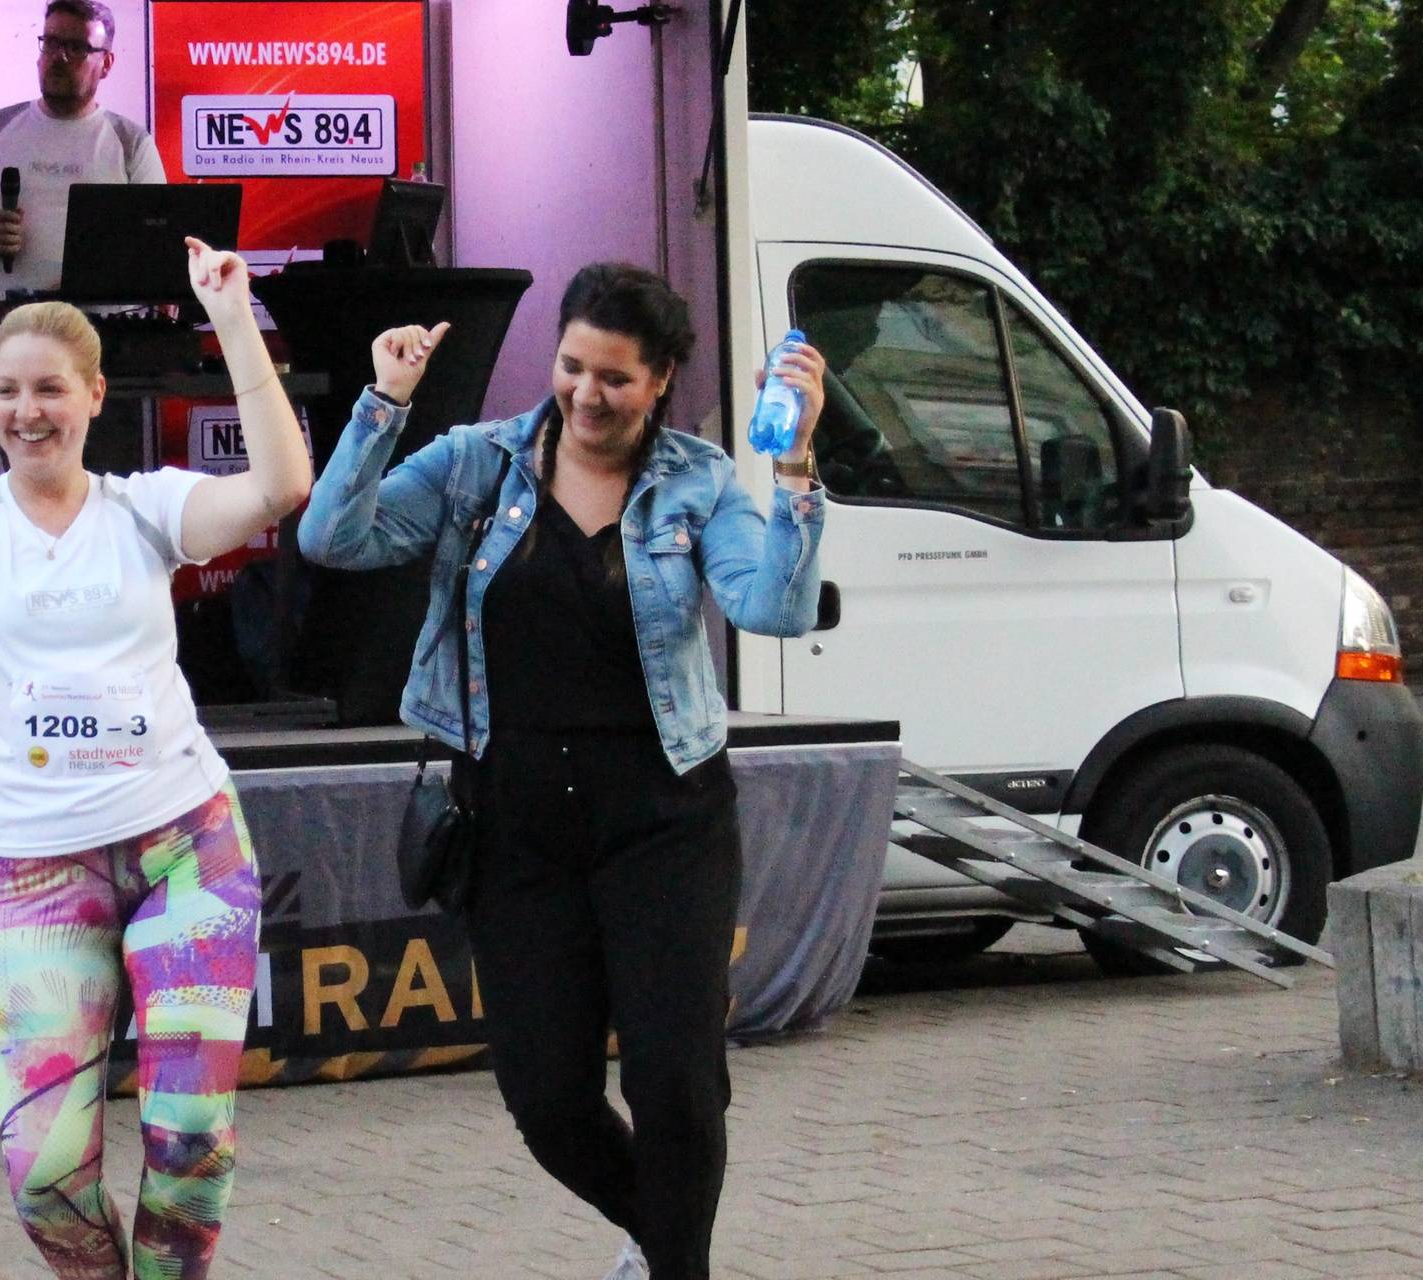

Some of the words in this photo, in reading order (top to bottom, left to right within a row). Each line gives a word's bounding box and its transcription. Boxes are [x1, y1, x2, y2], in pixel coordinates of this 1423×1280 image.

[188, 42, 386, 66] WWW.NEWS894.DE
[206, 98, 303, 146] NEWS
[314, 113, 372, 145] 89.4
[195, 155, 216, 165] Das
[223, 155, 254, 164] Radio
[261, 155, 274, 164] im
[280, 154, 345, 165] Rhein-Kreis
[351, 155, 384, 165] Neuss
[212, 423, 248, 455] NE
[24, 715, 99, 738] 1208
[130, 715, 148, 736] 3
[68, 744, 144, 761] stadtwerke
